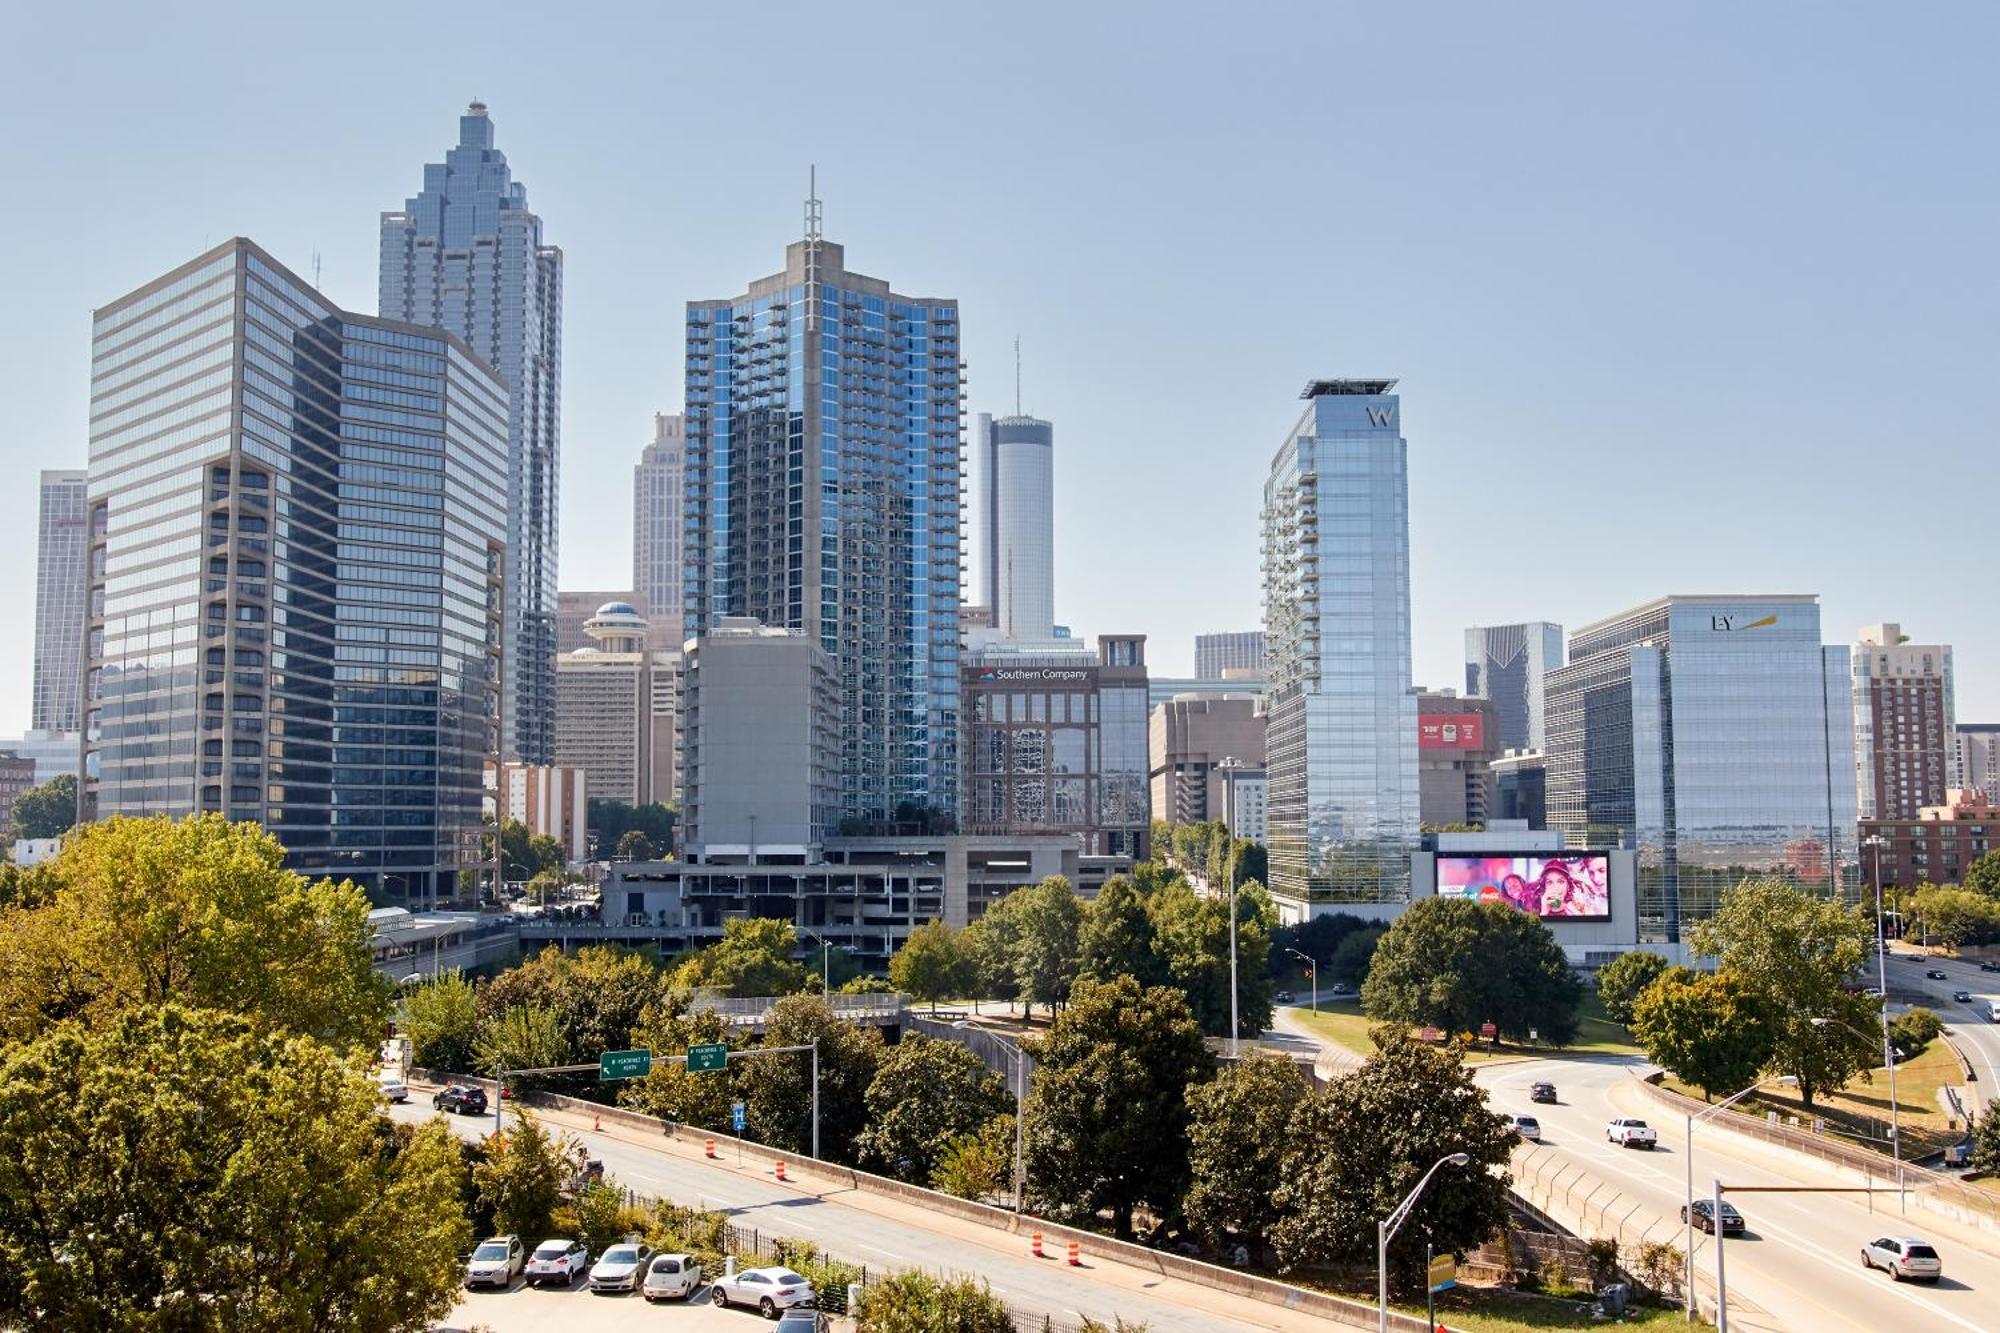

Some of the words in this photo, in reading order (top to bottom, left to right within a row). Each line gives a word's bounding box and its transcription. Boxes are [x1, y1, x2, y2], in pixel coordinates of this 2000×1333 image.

[1366, 406, 1392, 427] W
[1712, 615, 1734, 631] EY
[997, 669, 1040, 679] Southern
[1042, 669, 1087, 680] Company
[735, 1111, 744, 1122] H
